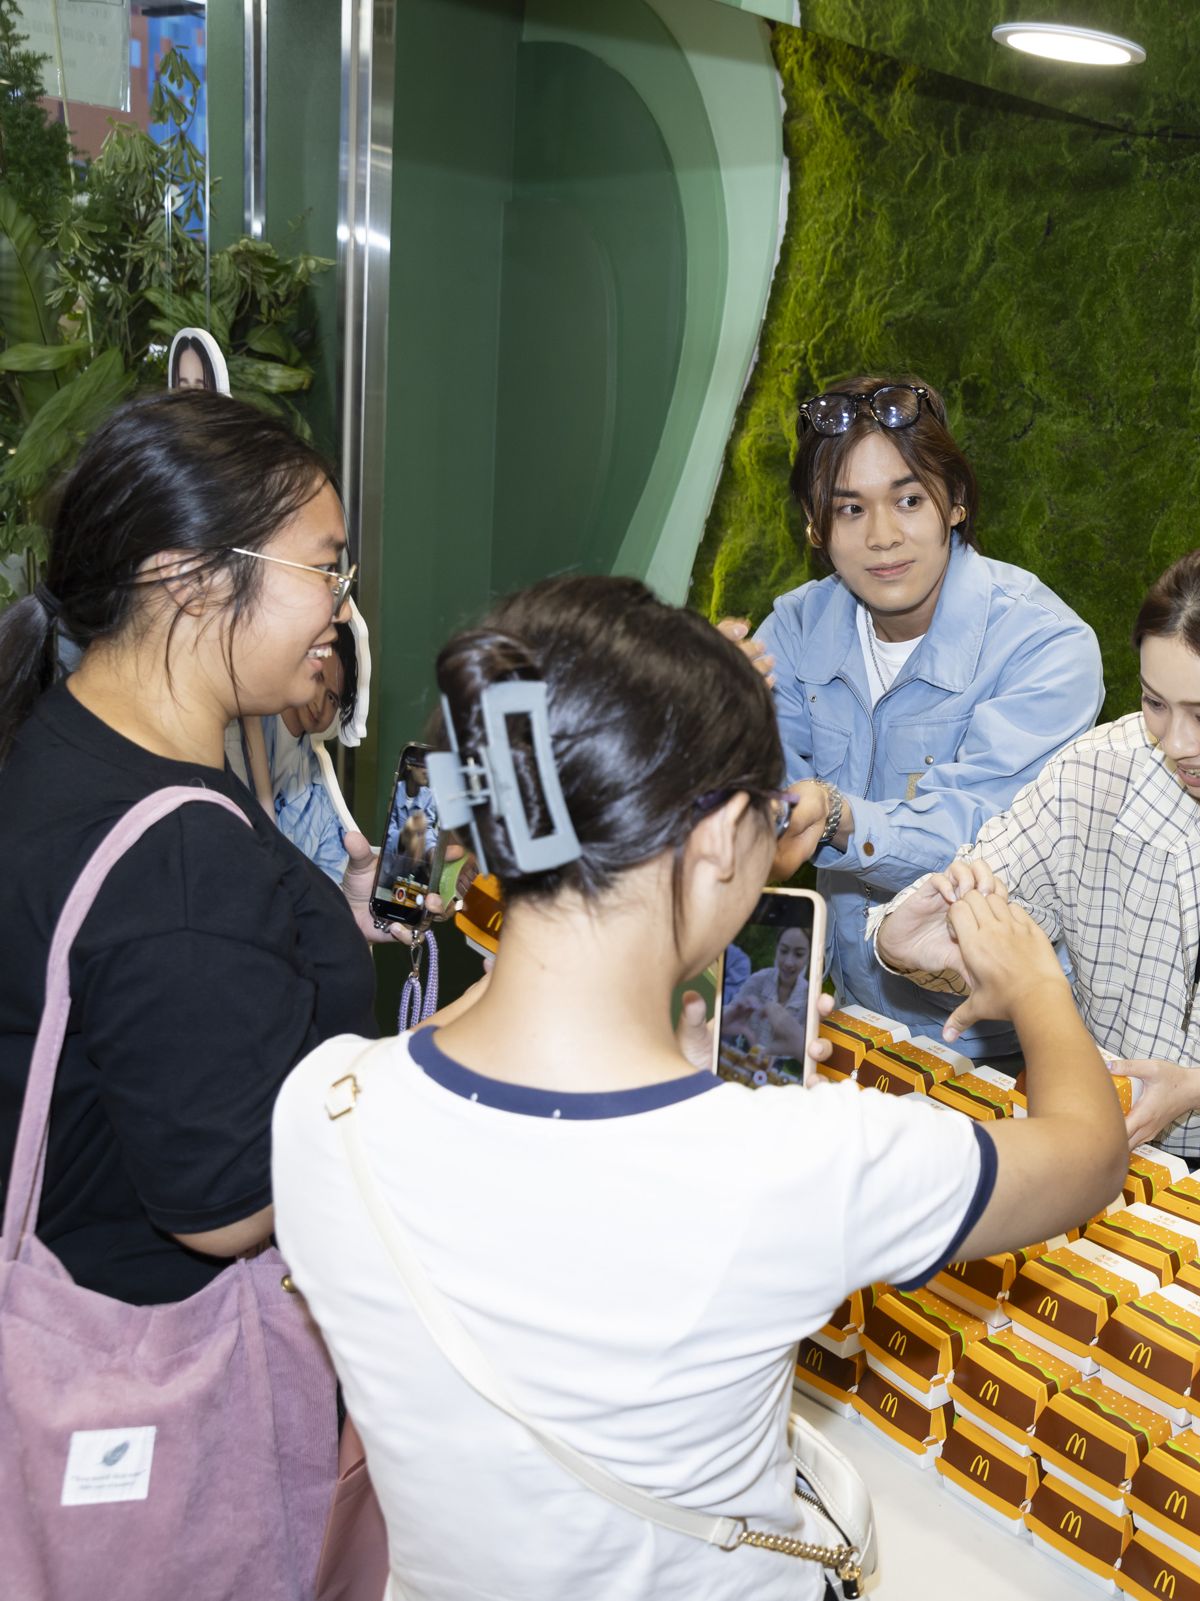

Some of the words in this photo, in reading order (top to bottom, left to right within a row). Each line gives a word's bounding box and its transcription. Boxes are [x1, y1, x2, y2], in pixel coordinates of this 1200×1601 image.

[1037, 1295, 1059, 1322] M
[888, 1330, 907, 1356] M
[1128, 1341, 1151, 1369] M
[805, 1347, 823, 1371] M
[879, 1392, 898, 1418] M
[979, 1379, 1000, 1407] M
[1065, 1432, 1087, 1461] M
[969, 1454, 990, 1482] M
[1164, 1490, 1188, 1520] M
[1059, 1510, 1082, 1539] M
[1153, 1569, 1176, 1600] M
